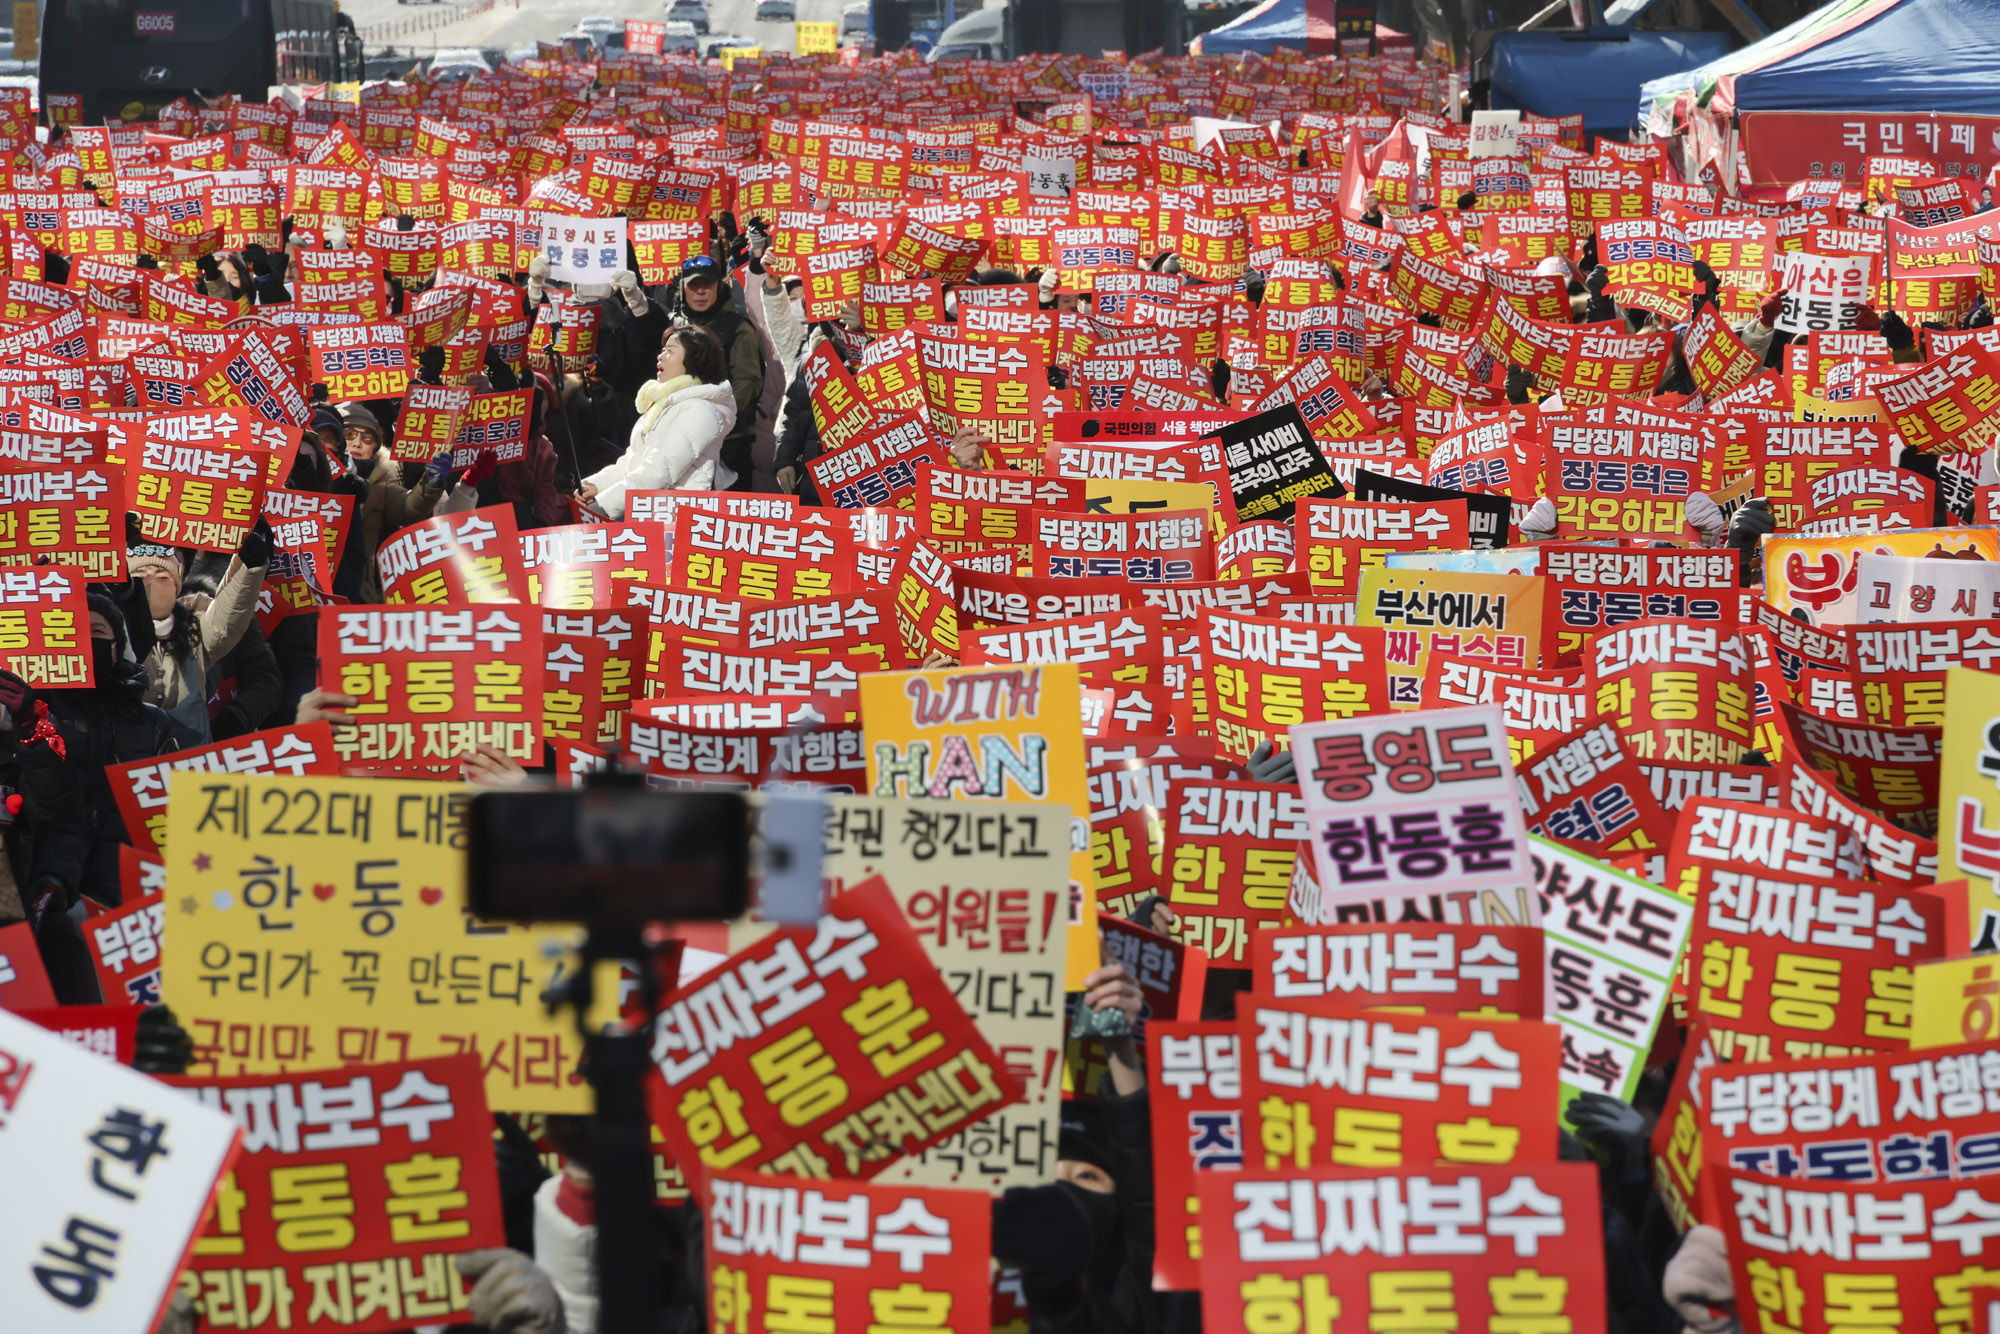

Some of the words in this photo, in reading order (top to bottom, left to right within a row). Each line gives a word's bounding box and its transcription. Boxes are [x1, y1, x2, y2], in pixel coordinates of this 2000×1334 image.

[829, 139, 903, 161] 진짜보수
[1157, 145, 1217, 172] 진짜보수
[295, 169, 362, 188] 진짜보수
[593, 157, 657, 183] 진짜보수
[1567, 169, 1643, 190] 진짜보수
[1870, 158, 1935, 178] 진짜보수
[210, 186, 276, 205] 진짜보수
[1076, 191, 1151, 214] 진짜보수
[1212, 183, 1285, 204] 진짜보수
[67, 210, 134, 229] 진짜보수
[440, 222, 509, 247] 진짜보수
[634, 223, 703, 240] 진짜보수
[817, 223, 878, 244] 진짜보수
[1183, 215, 1244, 238] 진짜보수
[1258, 206, 1334, 231] 진짜보수
[1498, 216, 1569, 234] 진짜보수
[1599, 222, 1657, 246] 부당징계
[1685, 220, 1767, 240] 진짜보수
[905, 220, 979, 254] 진짜보수
[1054, 228, 1104, 245] 부당징계
[1107, 227, 1139, 246] 자행한
[301, 251, 373, 268] 진짜보수
[807, 246, 875, 274] 진짜보수
[1061, 247, 1134, 265] 장동혁은
[1400, 251, 1480, 296] 진짜보수
[300, 280, 374, 302] 진짜보수
[863, 281, 932, 304] 진짜보수
[1094, 274, 1141, 292] 부당징계
[1144, 276, 1180, 295] 자행한
[1486, 266, 1556, 296] 진짜보수
[1606, 263, 1697, 289] 각오하라
[148, 280, 228, 319] 진짜보수
[960, 287, 1028, 307] 진짜보수
[49, 310, 84, 337] 자행한
[311, 327, 368, 348] 부당징계
[370, 325, 405, 344] 자행한
[965, 308, 1051, 332] 진짜보수
[1496, 303, 1571, 354] 진짜보수
[242, 330, 280, 390] 부당징계
[322, 349, 404, 373] 장동혁은
[922, 338, 1028, 375] 진짜보수
[1580, 336, 1666, 360] 진짜보수
[132, 356, 184, 379] 부당징계
[322, 371, 409, 399] 각오하라
[1083, 360, 1134, 382] 부당징계
[1140, 358, 1182, 379] 자행한
[1404, 349, 1493, 401] 진짜보수
[1880, 352, 1977, 413] 진짜보수
[409, 386, 470, 410] 진짜보수
[1131, 377, 1199, 412] 부당징계
[146, 413, 239, 442] 진짜보수
[1105, 421, 1156, 435] 국민의힘
[1162, 421, 1187, 435] 서울
[1251, 423, 1303, 458] 사이비
[1465, 422, 1509, 454] 자행한
[1552, 427, 1632, 457] 부당징계
[1640, 432, 1700, 463] 자행한
[1766, 427, 1879, 455] 진짜보수
[142, 441, 259, 482] 진짜보수
[394, 440, 429, 459] 우리가
[814, 441, 876, 489] 부당징계
[872, 419, 928, 460] 자행한
[1058, 447, 1186, 482] 진짜보수
[1280, 447, 1314, 474] 교주
[930, 469, 1069, 504] 진짜보수
[1562, 460, 1689, 495] 장동혁은
[1812, 468, 1925, 509] 진짜보수
[1308, 503, 1450, 541] 진짜보수
[1557, 495, 1686, 536] 각오하라
[690, 514, 835, 563] 진짜보수
[1038, 518, 1127, 552] 부당징계
[1135, 518, 1202, 551] 자행한
[379, 515, 498, 591] 진짜보수
[1548, 551, 1648, 586] 부당징계
[1655, 555, 1734, 588] 자행한
[748, 597, 881, 649] 진짜보수
[960, 591, 1029, 623] 시간은
[1375, 589, 1505, 629] 부산에서
[337, 610, 521, 654] 진짜보수
[1208, 613, 1364, 672] 진짜보수
[1757, 606, 1848, 665] 부당징계
[1595, 623, 1750, 677] 진짜보수
[1855, 627, 2000, 674] 진짜보수
[681, 647, 858, 698] 진짜보수
[904, 667, 1043, 730] WITH
[334, 722, 415, 760] 우리가
[629, 721, 760, 775] 부당징계
[874, 734, 1048, 799] HAN
[1312, 724, 1503, 801] 통영도
[1532, 722, 1625, 803] 자행한
[196, 784, 372, 843] 제22대
[902, 810, 1049, 860] 챙긴다고
[1321, 802, 1515, 884] 한동훈
[1687, 801, 1865, 883] 진짜보수
[907, 887, 1058, 954] 의원들!
[1708, 869, 1927, 957] 진짜보수
[198, 941, 317, 998] 우리가
[340, 950, 382, 1004] 꼭
[410, 952, 531, 1005] 만든다
[1271, 934, 1519, 997] 진짜보수
[649, 915, 880, 1085] 진짜보수
[1256, 1008, 1521, 1107] 진짜보수
[1709, 1068, 1879, 1137] 부당징계
[711, 1179, 952, 1273] 진짜보수
[1234, 1176, 1565, 1262] 진짜보수
[1730, 1178, 2000, 1261] 진짜보수
